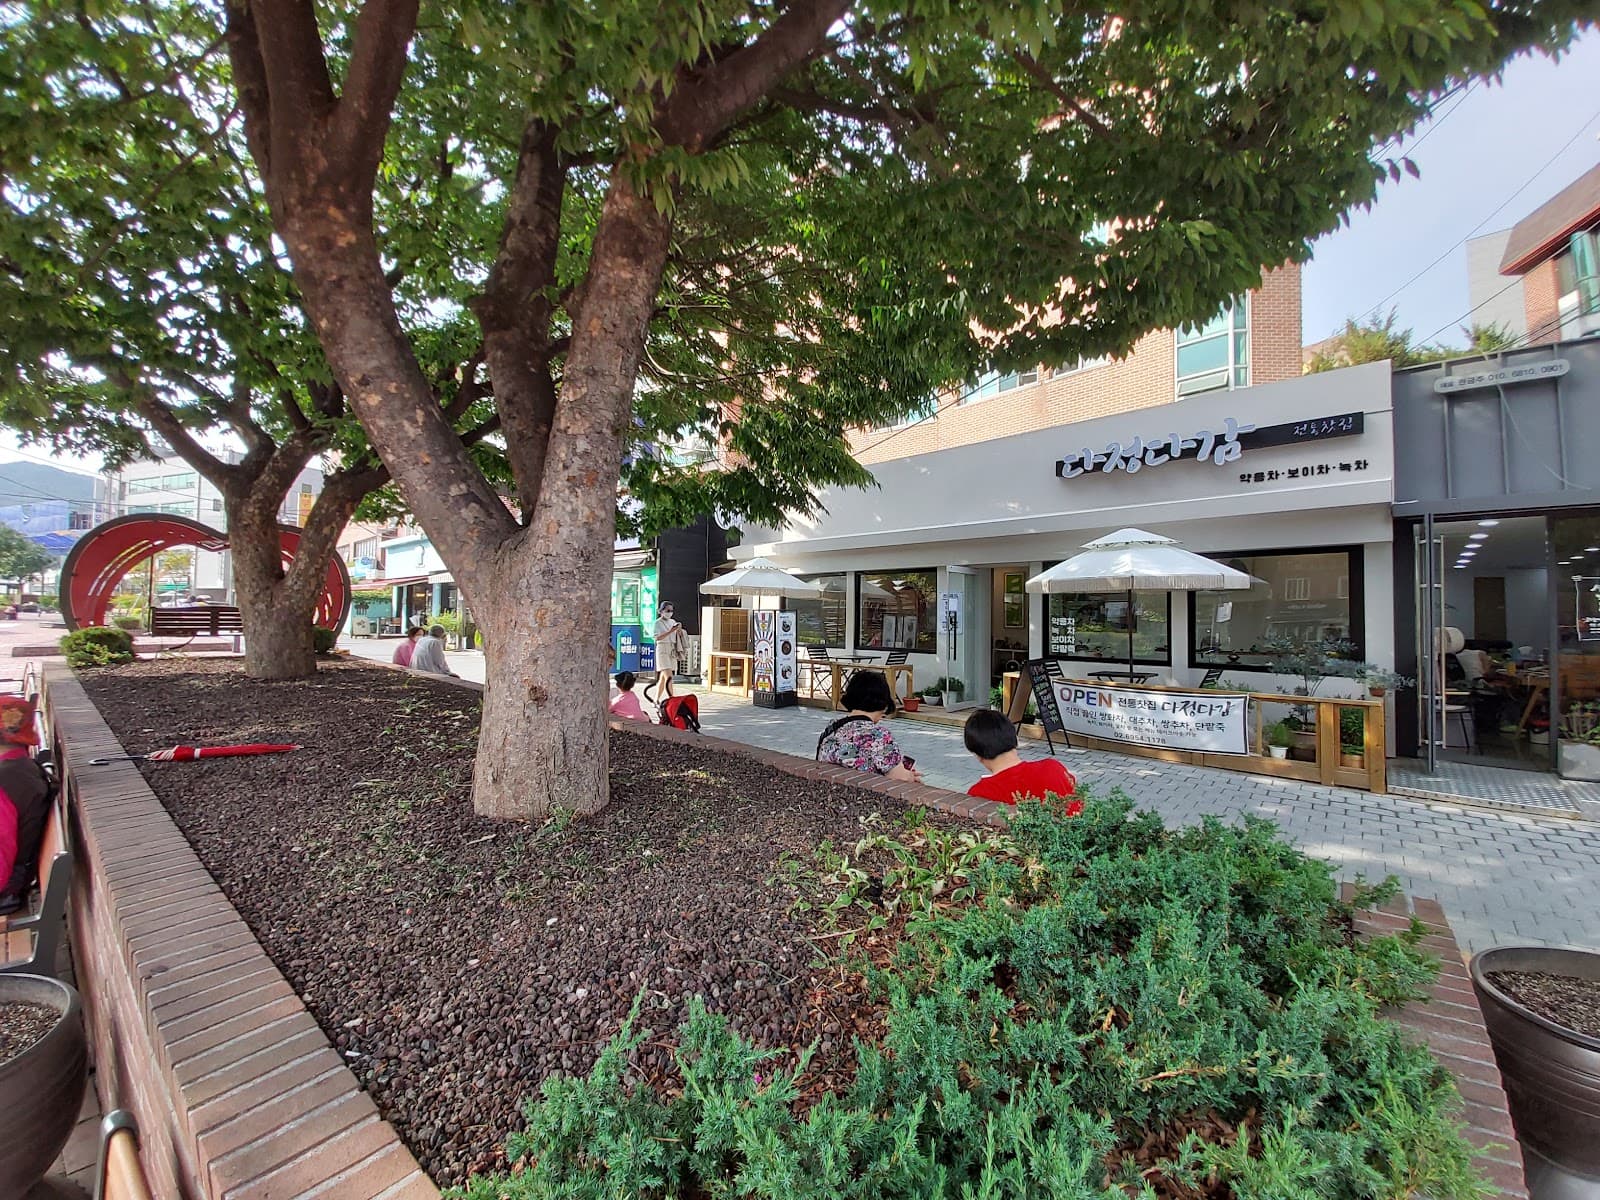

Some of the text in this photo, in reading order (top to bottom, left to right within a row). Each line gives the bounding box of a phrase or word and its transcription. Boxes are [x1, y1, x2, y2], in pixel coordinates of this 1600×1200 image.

[1293, 416, 1353, 437] 전통찻집
[1062, 417, 1255, 480] 다정다감
[1051, 635, 1076, 644] 보이차
[1060, 687, 1112, 708] OPEN
[1118, 697, 1236, 717] 전통찻집 다정다감
[1065, 706, 1080, 717] 직접
[1195, 722, 1226, 733] 단팥죽
